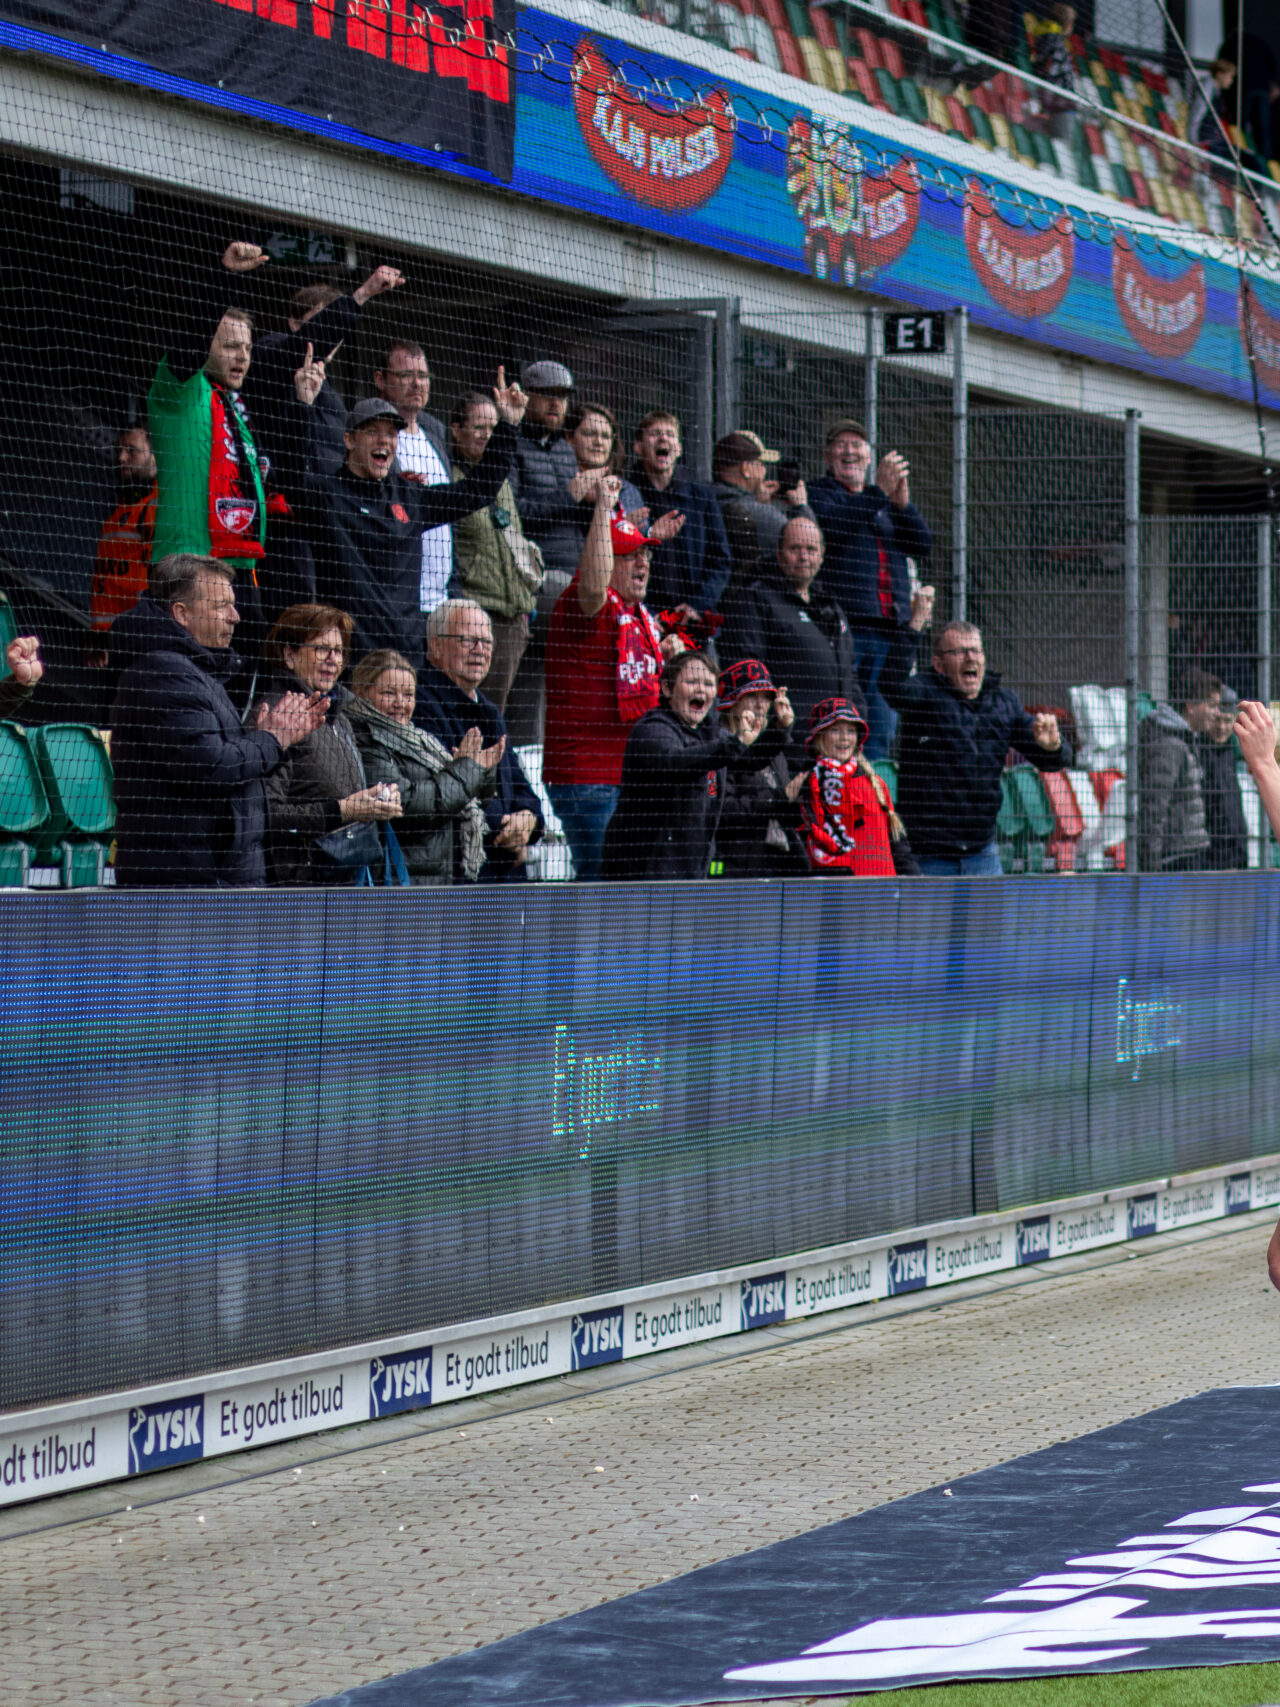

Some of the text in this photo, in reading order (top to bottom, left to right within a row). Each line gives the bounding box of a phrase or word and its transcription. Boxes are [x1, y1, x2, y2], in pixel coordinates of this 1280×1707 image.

[897, 317, 933, 349] E1
[895, 1231, 1002, 1284] JYSK Et godt tilbud
[1022, 1207, 1115, 1255] JYSK Et godt tilbud
[749, 1260, 871, 1318] JYSK Et godt tilbud
[580, 1291, 722, 1357] JYSK Et godt tilbud
[381, 1330, 549, 1403] JYSK Et godt tilbud
[31, 1427, 96, 1478] tilbud
[142, 1405, 202, 1456] JYSK
[220, 1399, 239, 1437] Et
[243, 1387, 287, 1442] godt
[290, 1375, 344, 1420] tilbud
